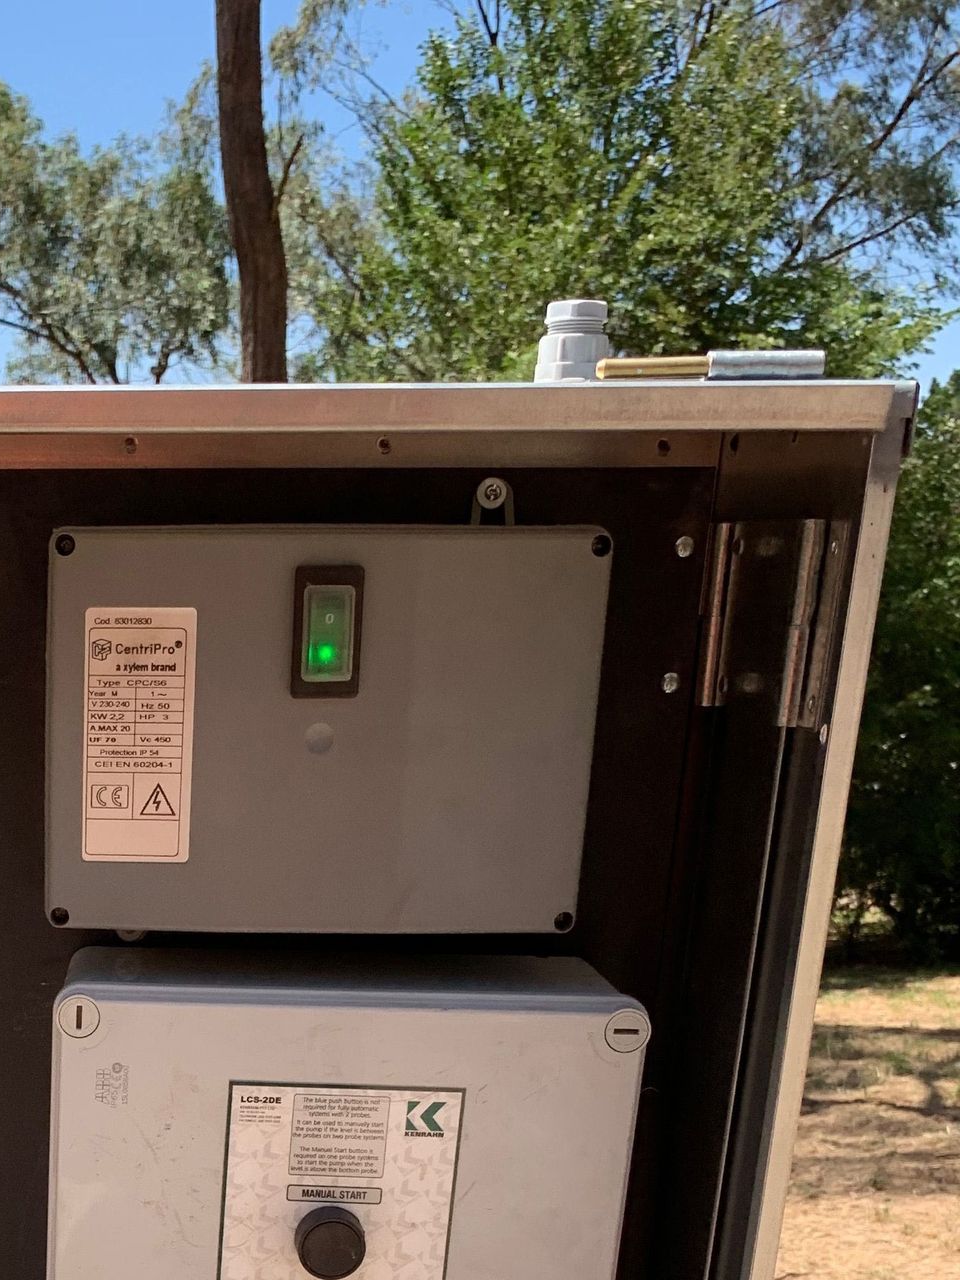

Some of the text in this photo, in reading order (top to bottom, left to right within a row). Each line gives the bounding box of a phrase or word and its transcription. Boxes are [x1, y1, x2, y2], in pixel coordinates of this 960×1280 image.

[116, 662, 176, 674] a xylem brand
[97, 680, 121, 688] Type
[240, 1095, 282, 1104] LCS-2DE
[301, 1189, 367, 1200] MANUAL START
